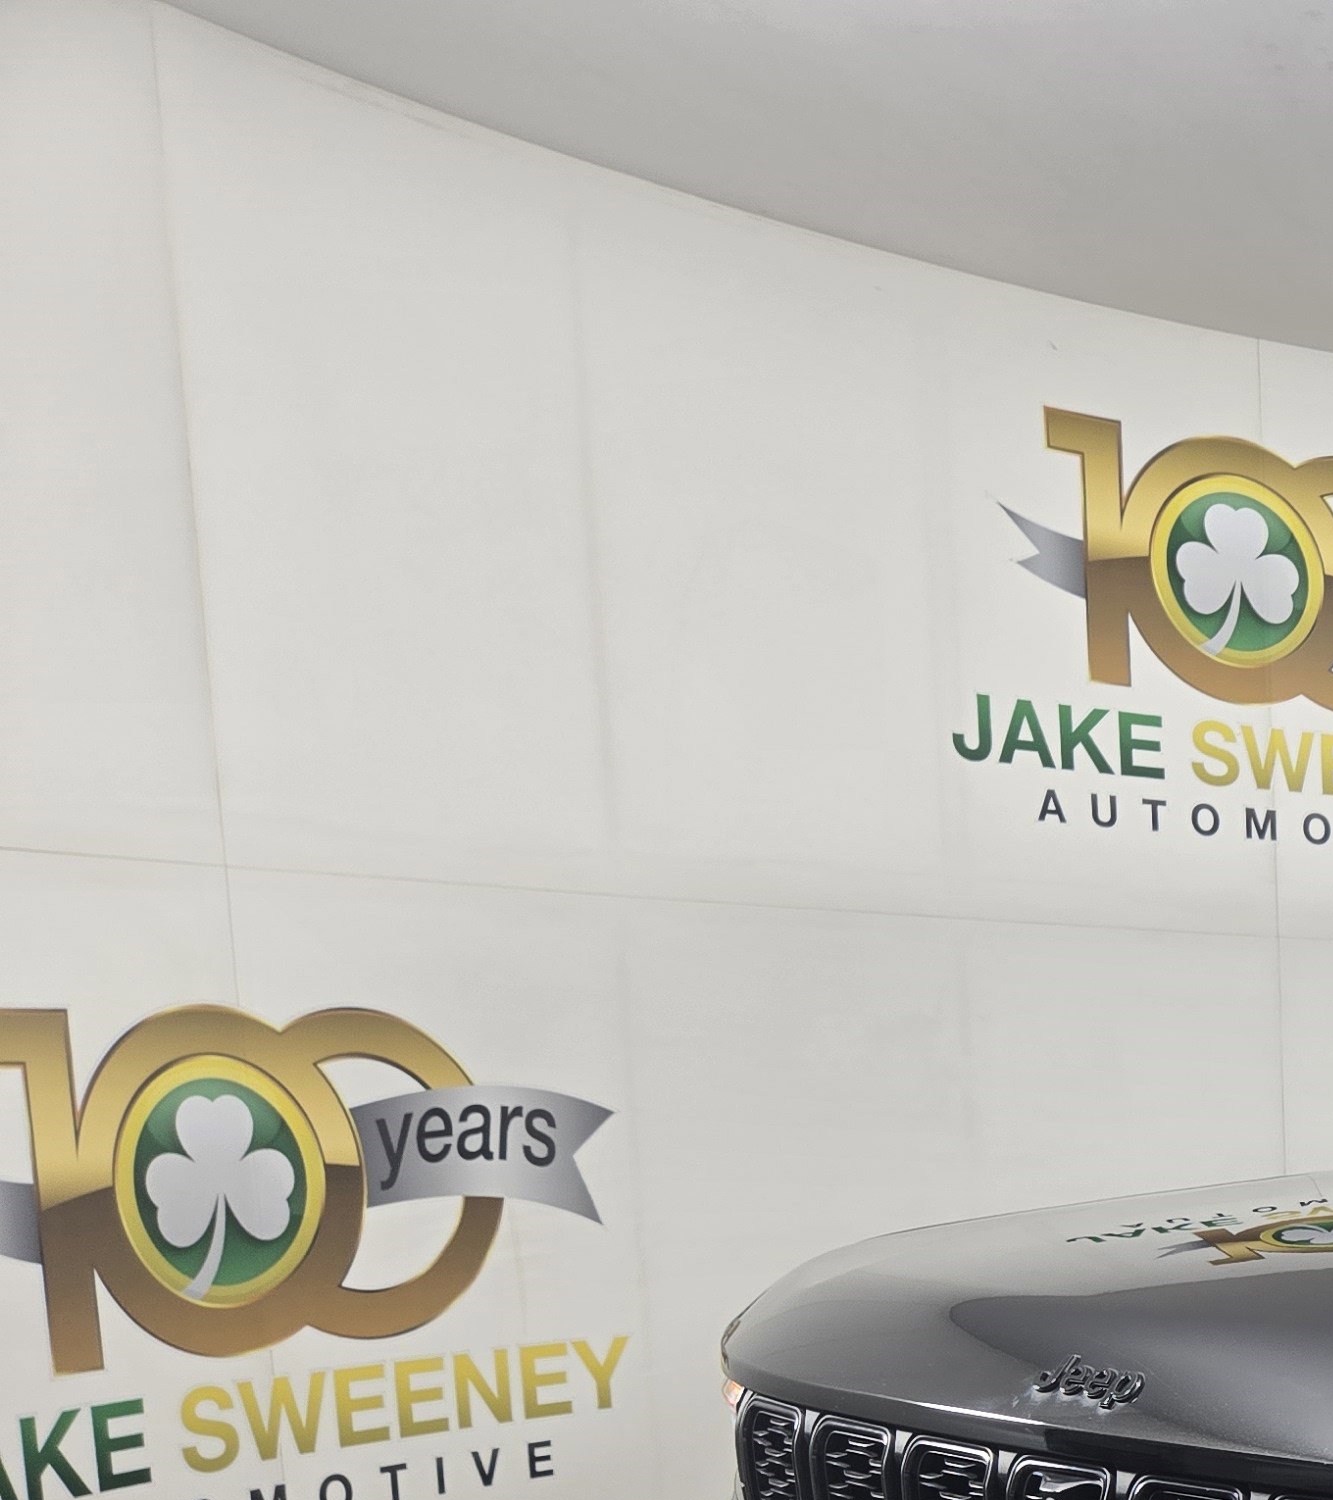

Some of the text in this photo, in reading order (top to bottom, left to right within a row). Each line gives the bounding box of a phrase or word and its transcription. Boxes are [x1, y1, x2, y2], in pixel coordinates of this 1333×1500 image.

[952, 693, 1165, 780] JAKE
[375, 1103, 557, 1190] years
[180, 1335, 630, 1473] SWEENEY
[1033, 1354, 1145, 1410] Jeep
